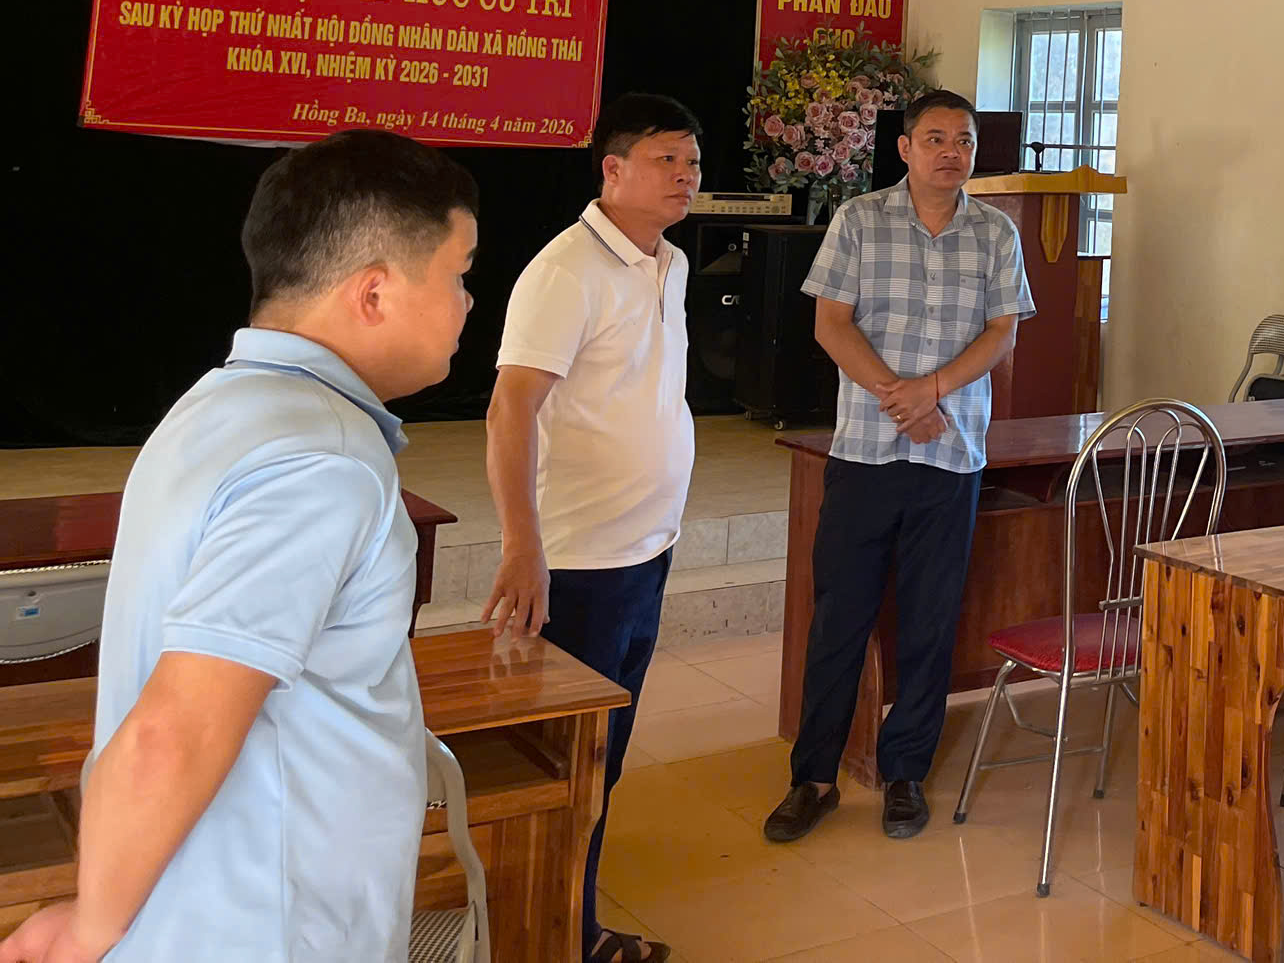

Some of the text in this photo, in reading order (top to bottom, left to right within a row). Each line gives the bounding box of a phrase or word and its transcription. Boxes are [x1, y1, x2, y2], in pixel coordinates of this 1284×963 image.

[119, 0, 582, 61] SAU KỲ HỌP THỨ NHẤT HỘI ĐỒNG NHÂN DÂN XÃ HỒNG THÁI
[227, 44, 273, 73] KHÓA
[279, 50, 310, 78] XVI,
[315, 51, 370, 83] NHIỆM
[375, 54, 396, 80] KỲ
[400, 60, 439, 84] 2026
[453, 64, 488, 87] 2031
[292, 99, 574, 135] Hồng Ba, ngày 14 tháng 4 năm 2026
